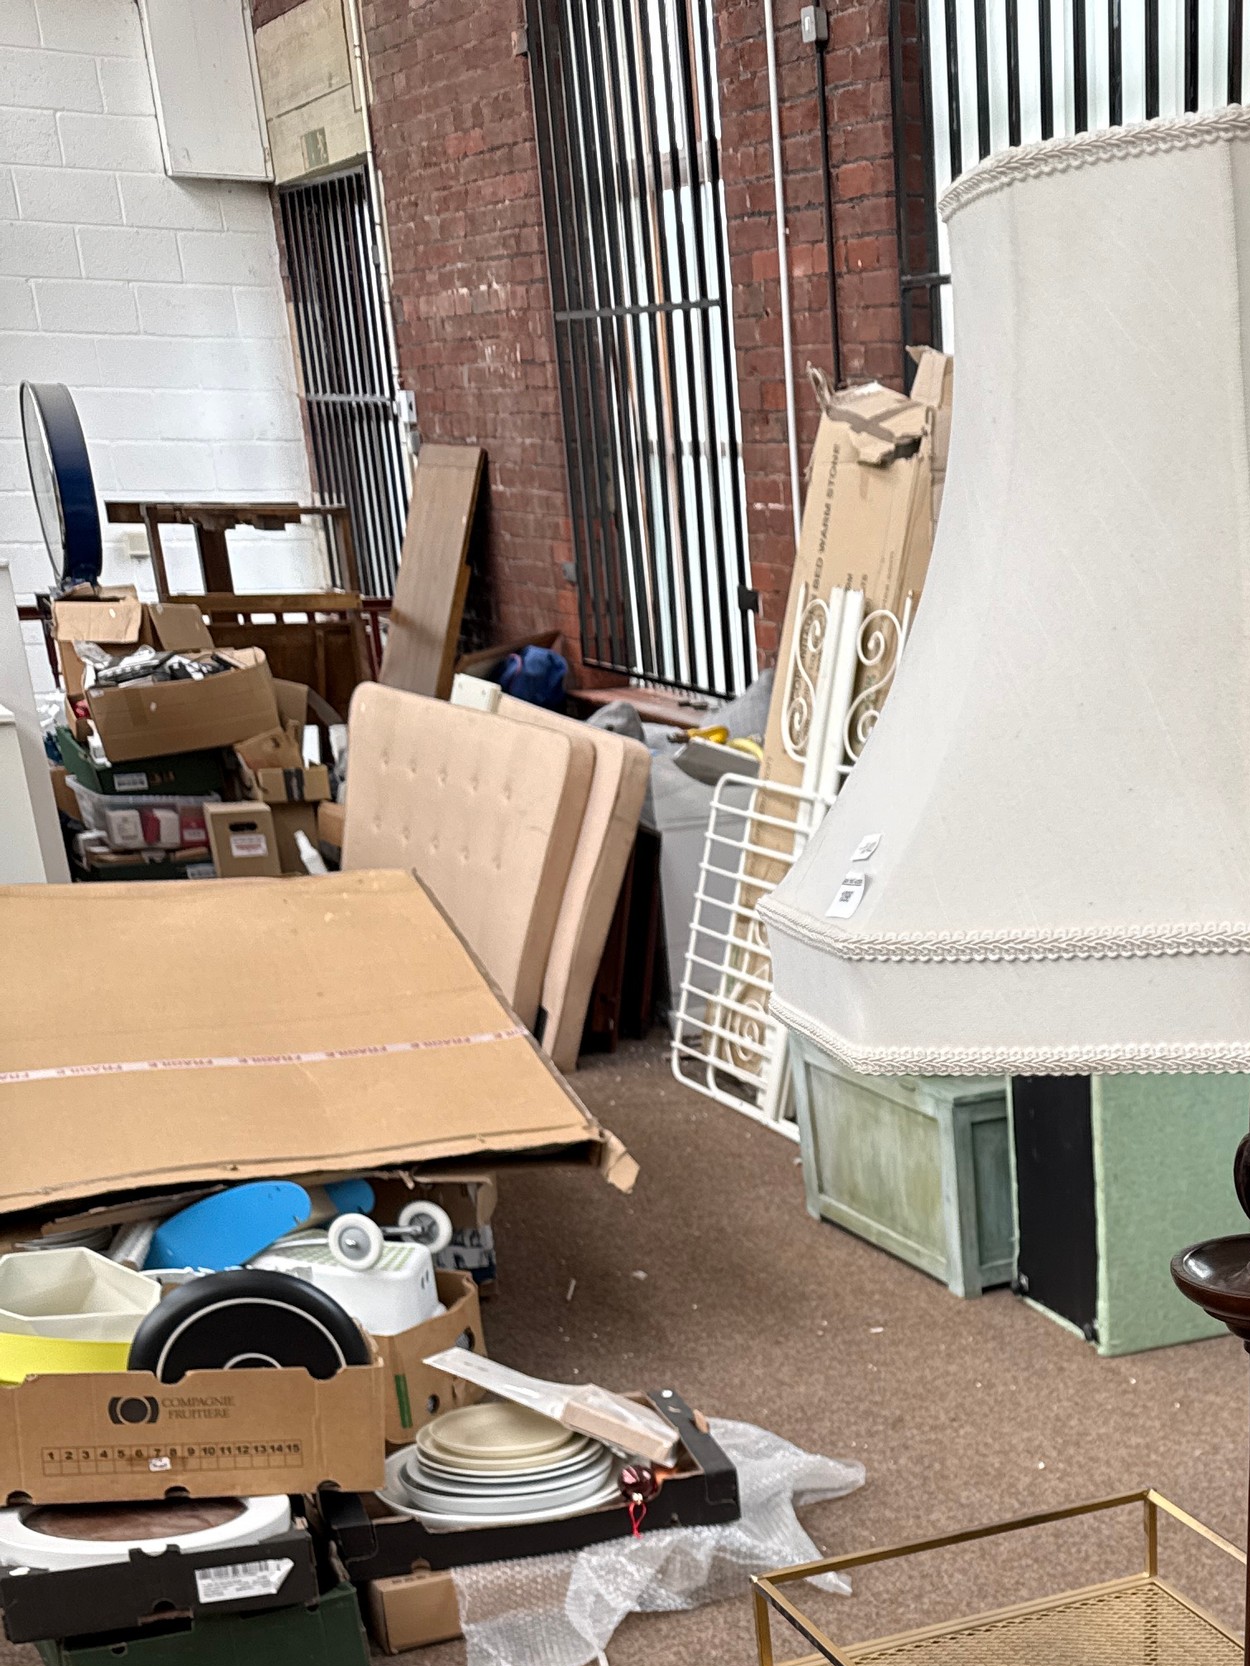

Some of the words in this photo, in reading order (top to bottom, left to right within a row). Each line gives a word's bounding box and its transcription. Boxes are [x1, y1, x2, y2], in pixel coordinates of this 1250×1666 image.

[826, 443, 841, 499] STONE
[818, 503, 832, 553] WARM
[813, 557, 824, 590] BED
[161, 1396, 236, 1408] COMPAGNIE
[64, 1450, 73, 1460] 2
[81, 1449, 90, 1460] 3
[99, 1449, 108, 1459] 4
[117, 1449, 126, 1459] 5
[135, 1448, 144, 1459] 6
[154, 1447, 162, 1458] 7
[169, 1447, 177, 1457] 8
[187, 1446, 196, 1457] 9
[202, 1446, 216, 1457] 10
[220, 1445, 232, 1455] 11
[236, 1444, 250, 1455] 12
[253, 1444, 267, 1454] 13
[269, 1443, 283, 1453] 14
[286, 1443, 300, 1453] 15
